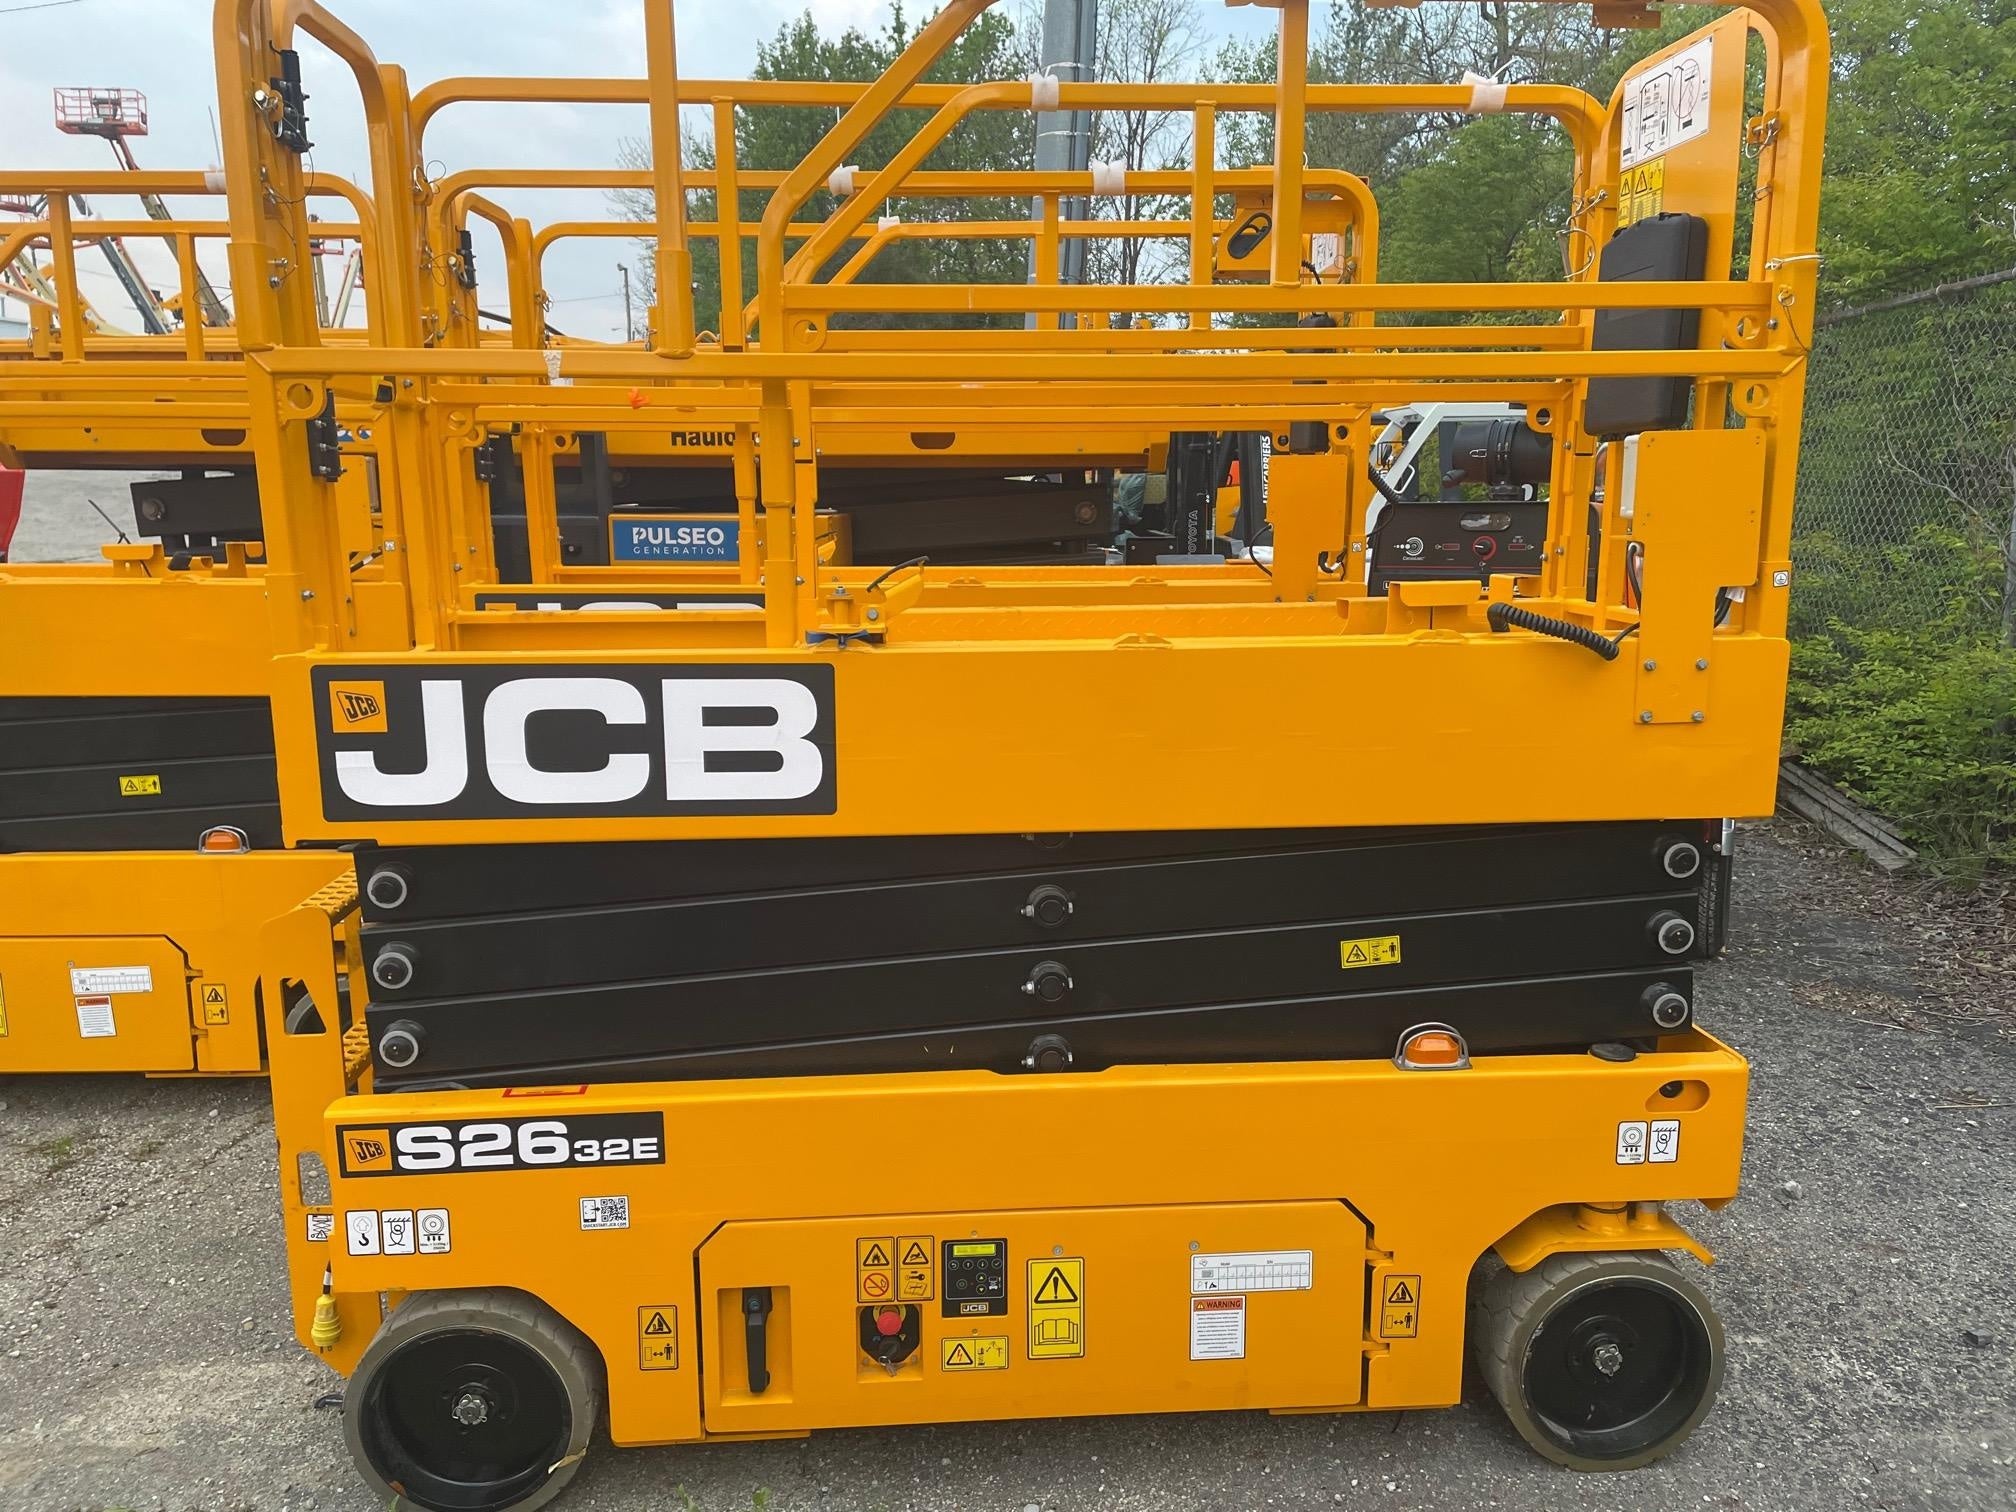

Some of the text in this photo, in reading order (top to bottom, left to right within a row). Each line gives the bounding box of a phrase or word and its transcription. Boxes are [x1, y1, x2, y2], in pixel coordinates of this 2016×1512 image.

[632, 527, 725, 546] PULSEO
[1187, 509, 1199, 554] OYOTA
[633, 546, 725, 555] GENERATION
[345, 694, 378, 719] JCB
[334, 677, 823, 806] JCB
[356, 1139, 384, 1160] JCB
[962, 1304, 987, 1312] JCB
[1206, 1299, 1241, 1309] WARNING
